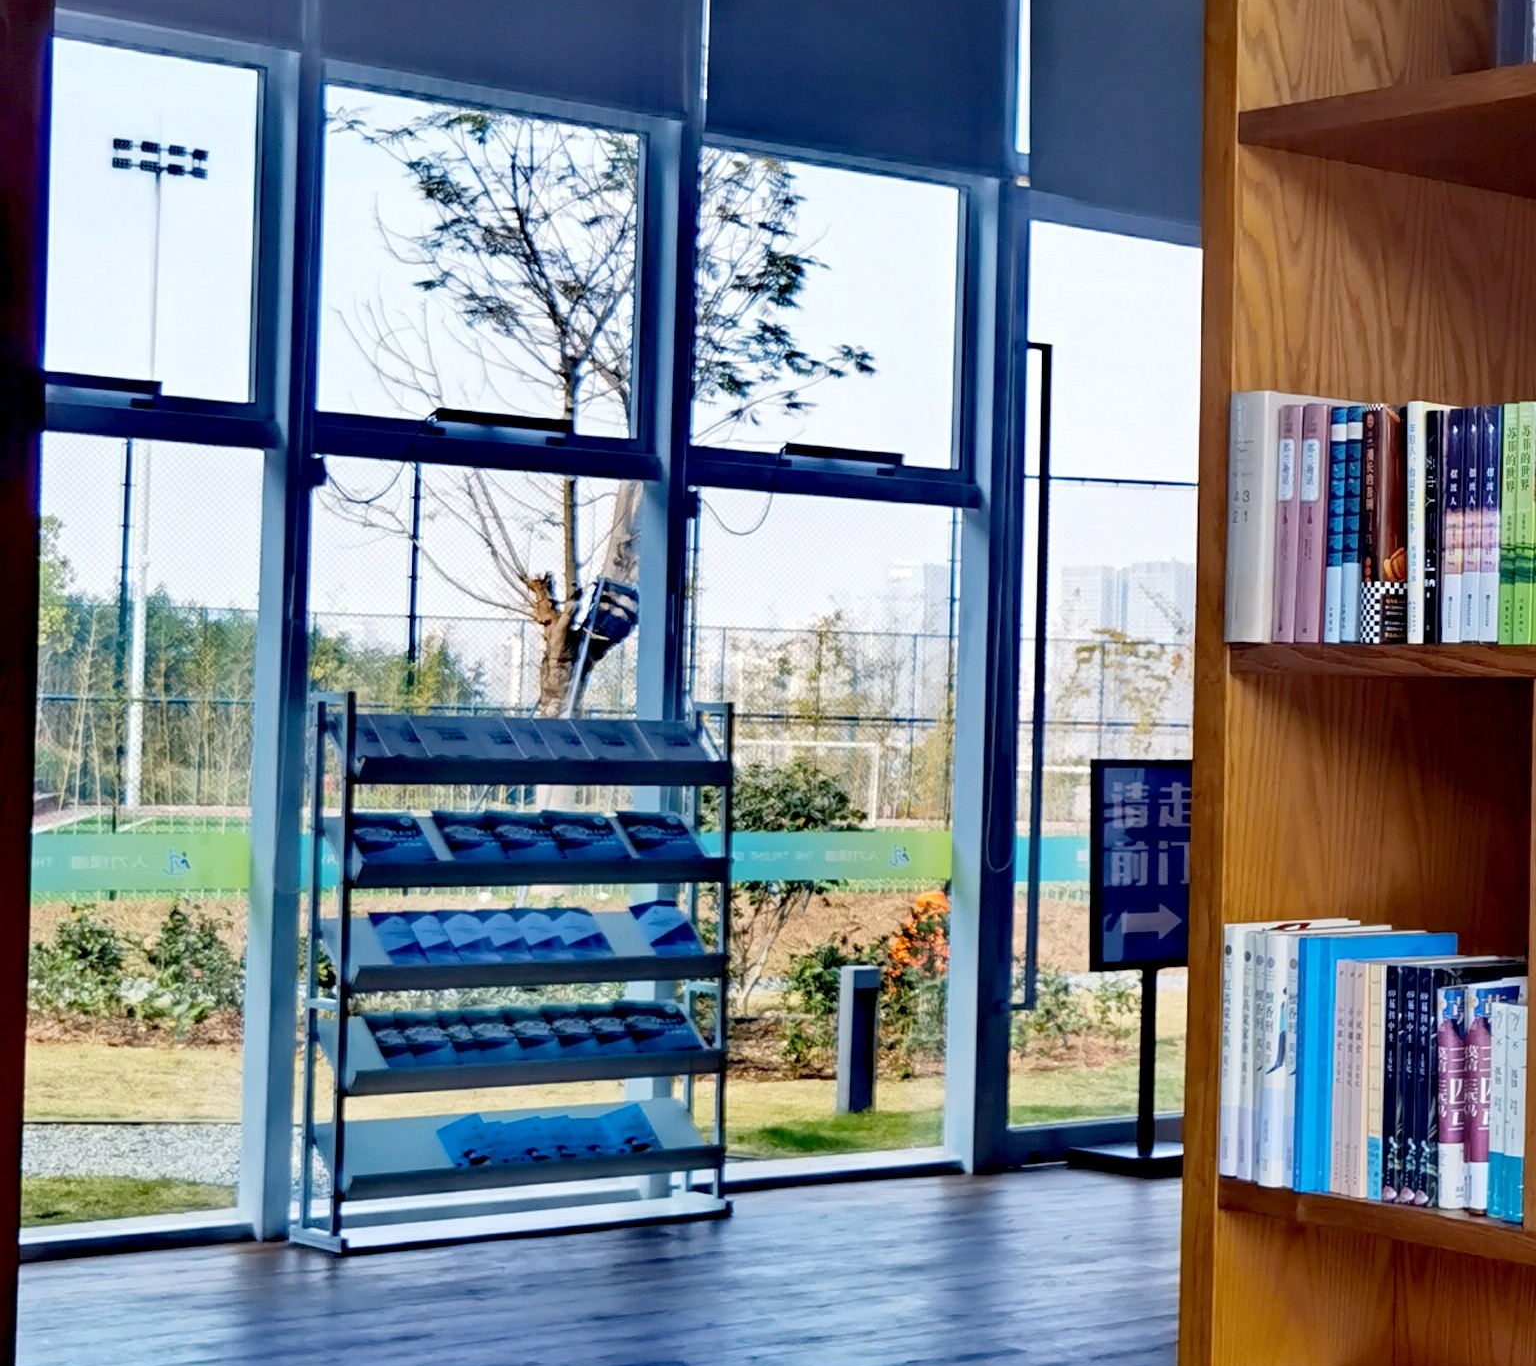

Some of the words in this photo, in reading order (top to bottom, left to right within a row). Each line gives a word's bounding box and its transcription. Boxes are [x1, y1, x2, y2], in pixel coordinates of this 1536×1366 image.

[1506, 426, 1517, 493] 苏菲的世界
[1520, 422, 1531, 491] 苏菲的世界
[1112, 782, 1191, 828] 请走
[1111, 841, 1190, 886] 前门
